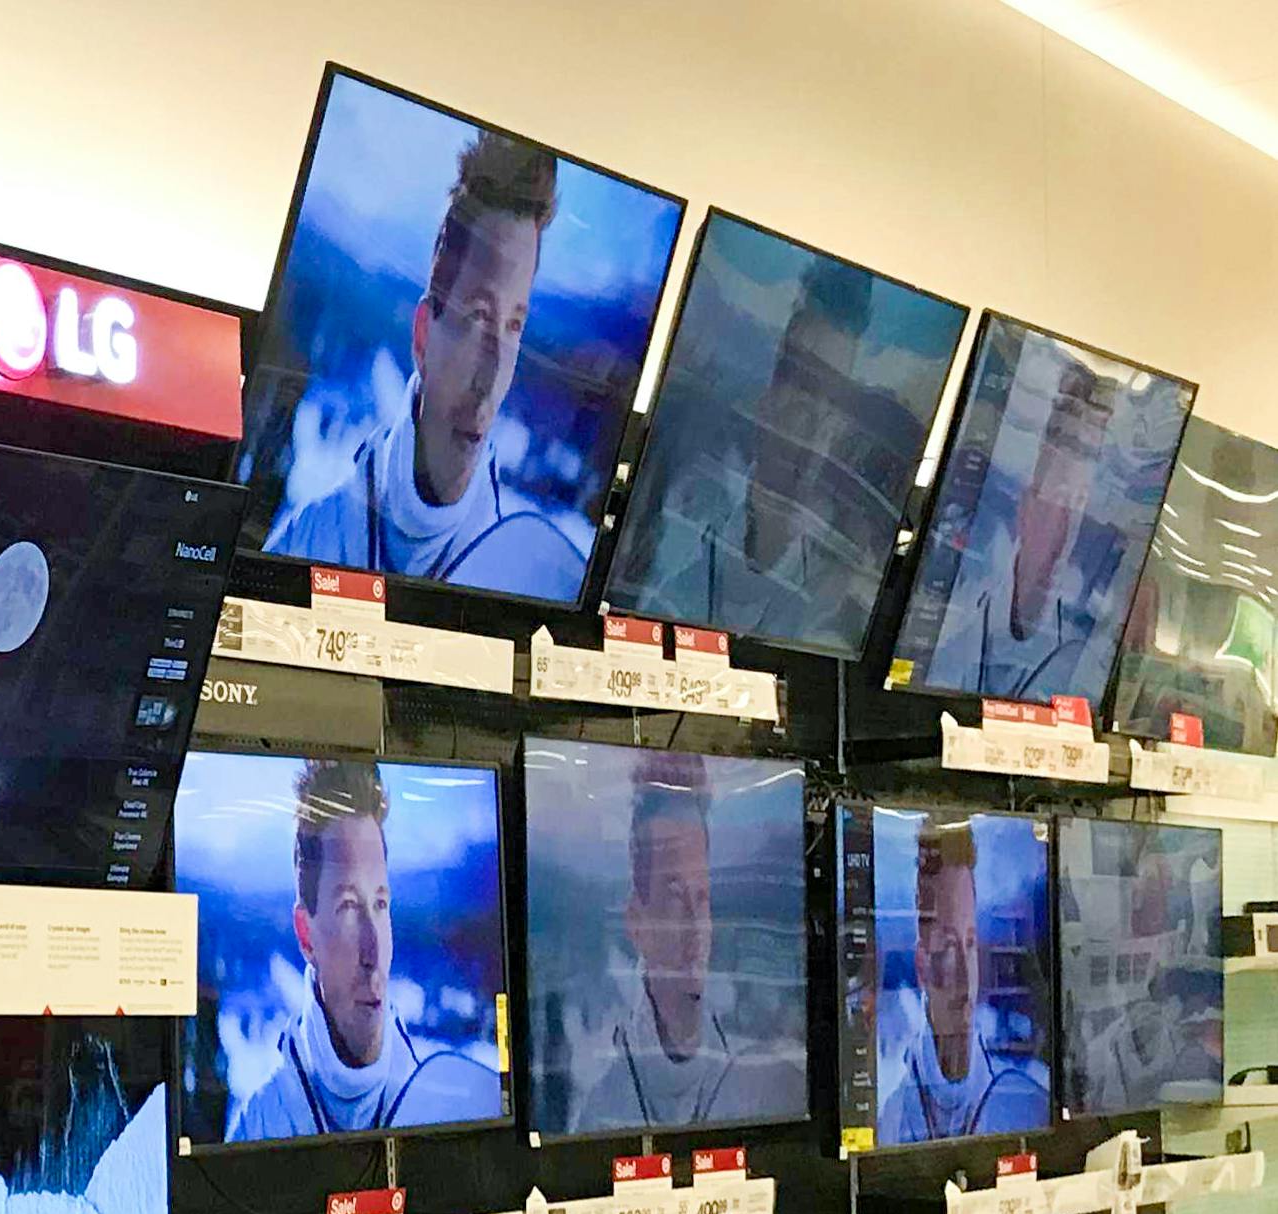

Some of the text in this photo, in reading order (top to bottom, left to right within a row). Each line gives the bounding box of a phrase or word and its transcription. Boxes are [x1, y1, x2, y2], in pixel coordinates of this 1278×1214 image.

[53, 287, 137, 385] LG
[175, 542, 217, 564] NanoCell
[200, 677, 258, 706] SONY
